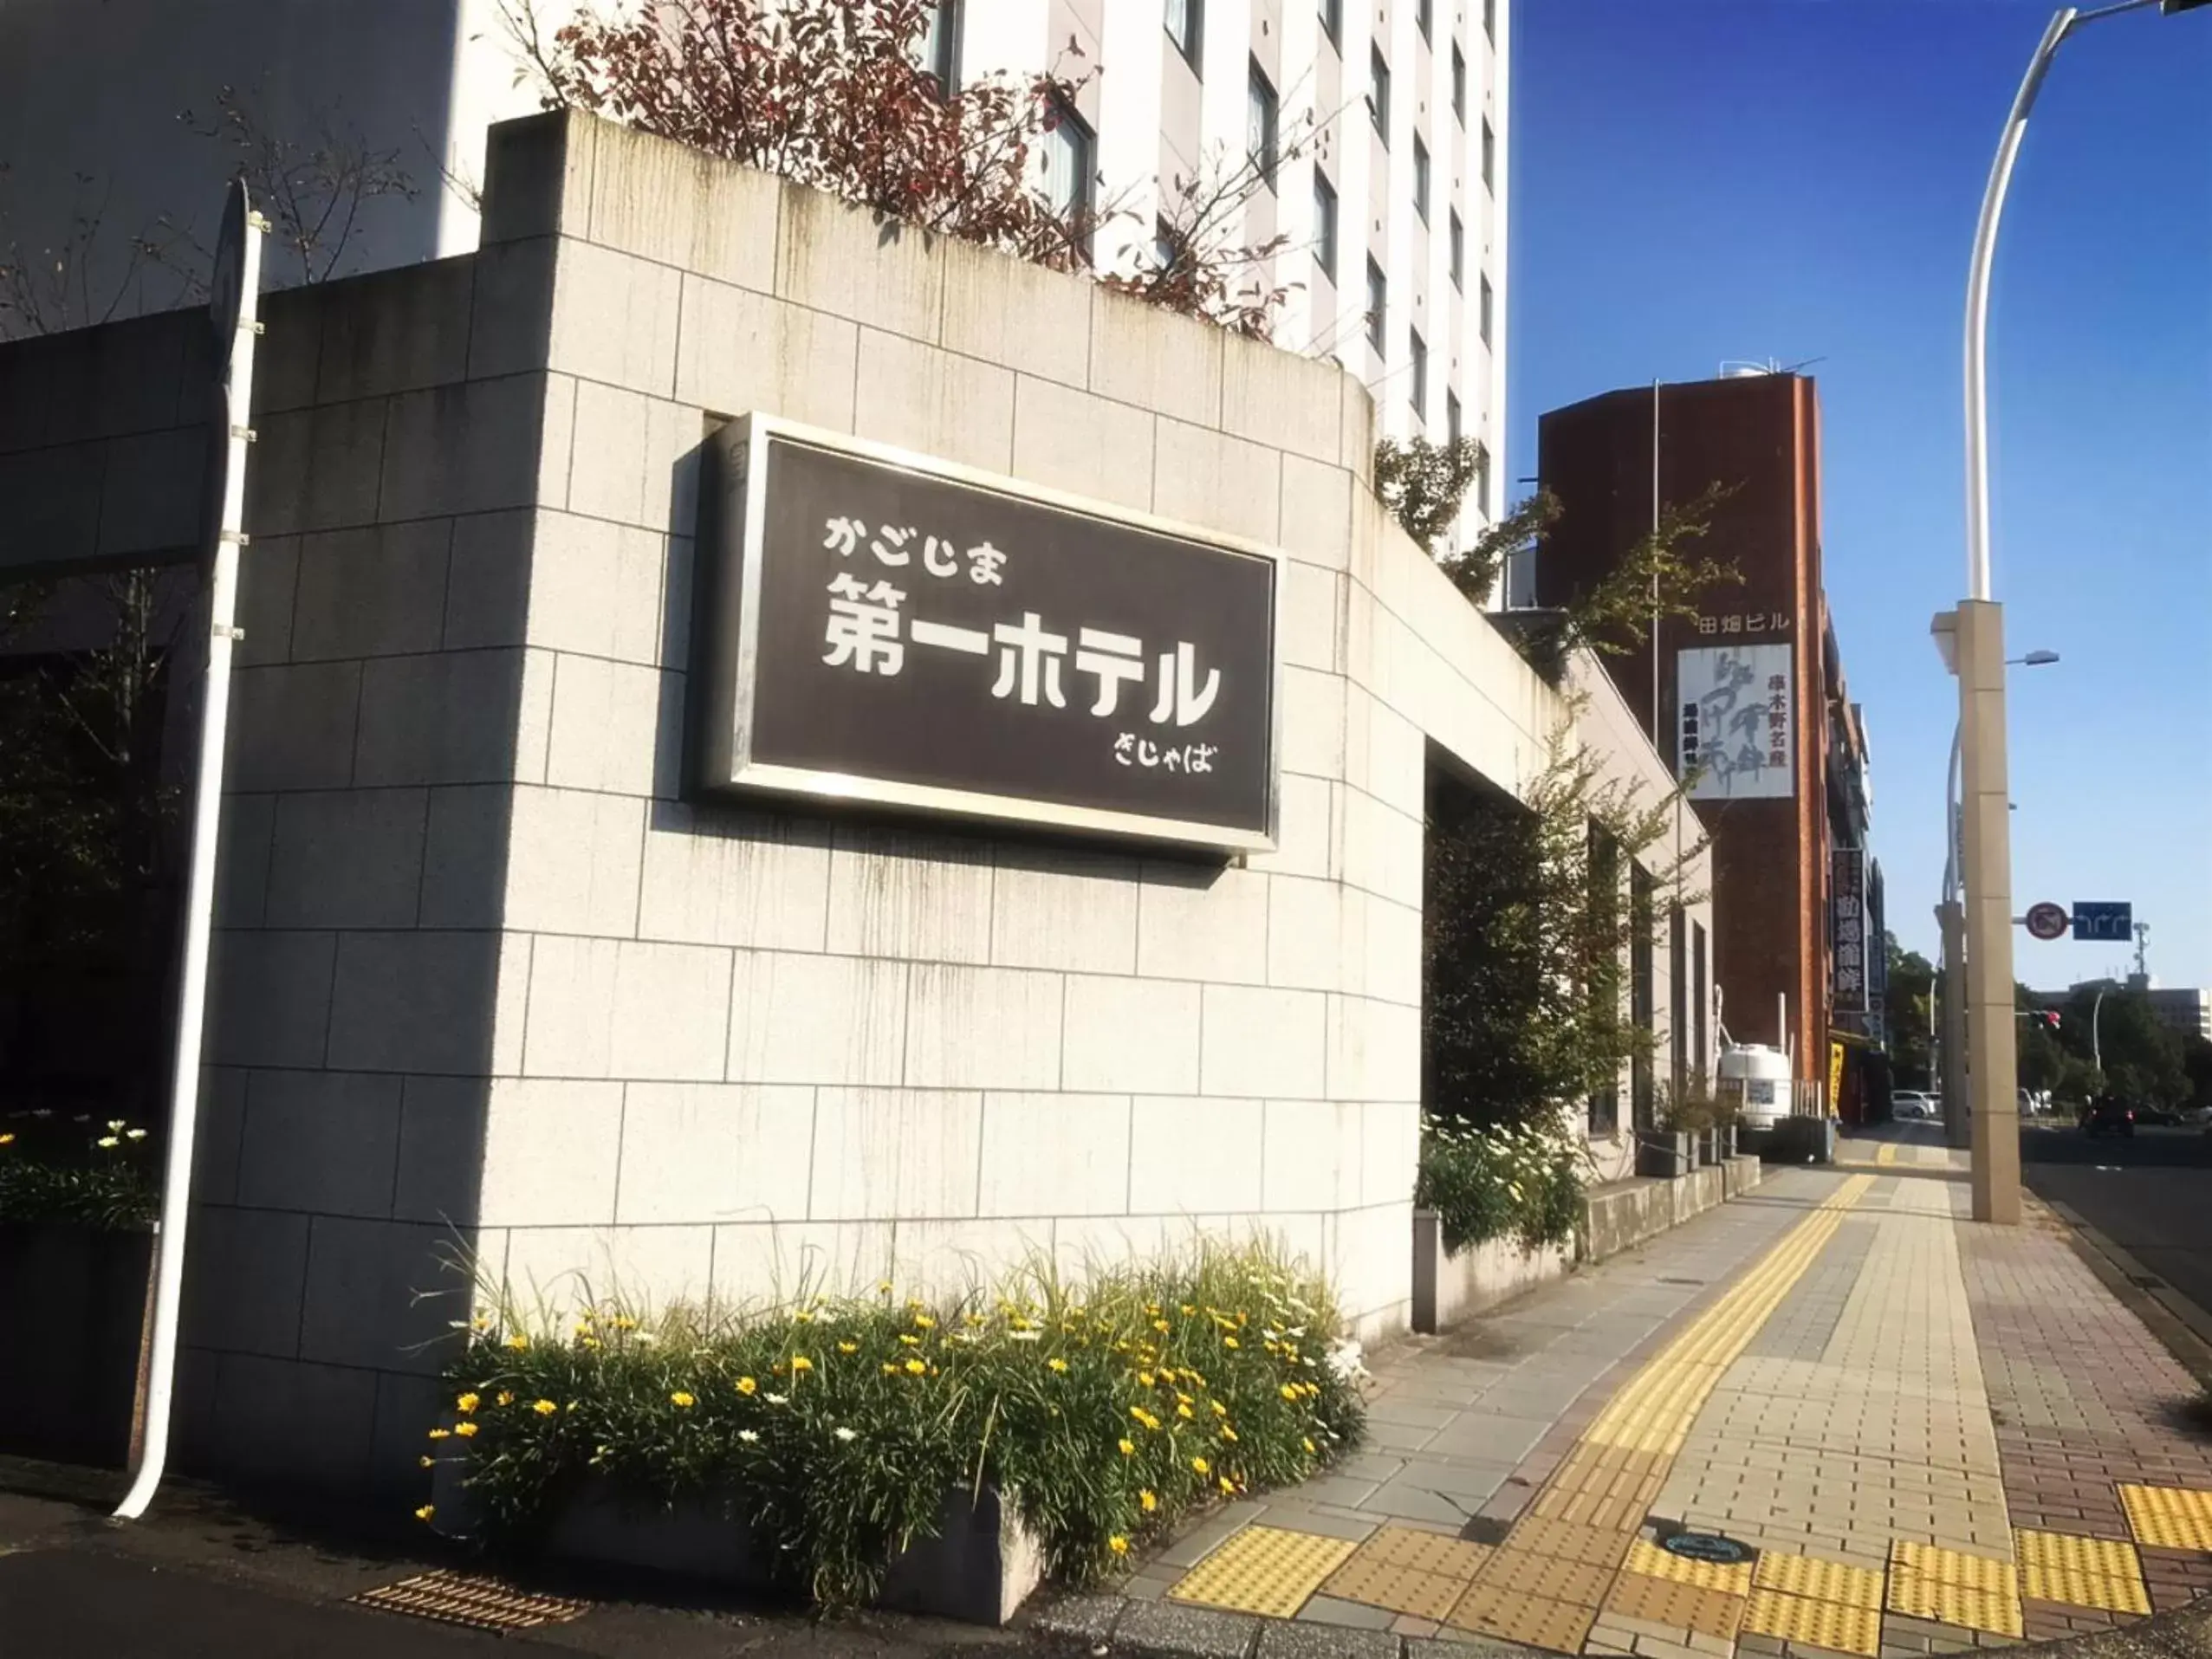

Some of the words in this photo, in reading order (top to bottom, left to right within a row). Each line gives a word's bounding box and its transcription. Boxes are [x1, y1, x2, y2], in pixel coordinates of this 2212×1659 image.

[822, 515, 1007, 586] かごじま
[821, 571, 1221, 727] 第一ホテル
[1699, 611, 1790, 634] 田畑ビル
